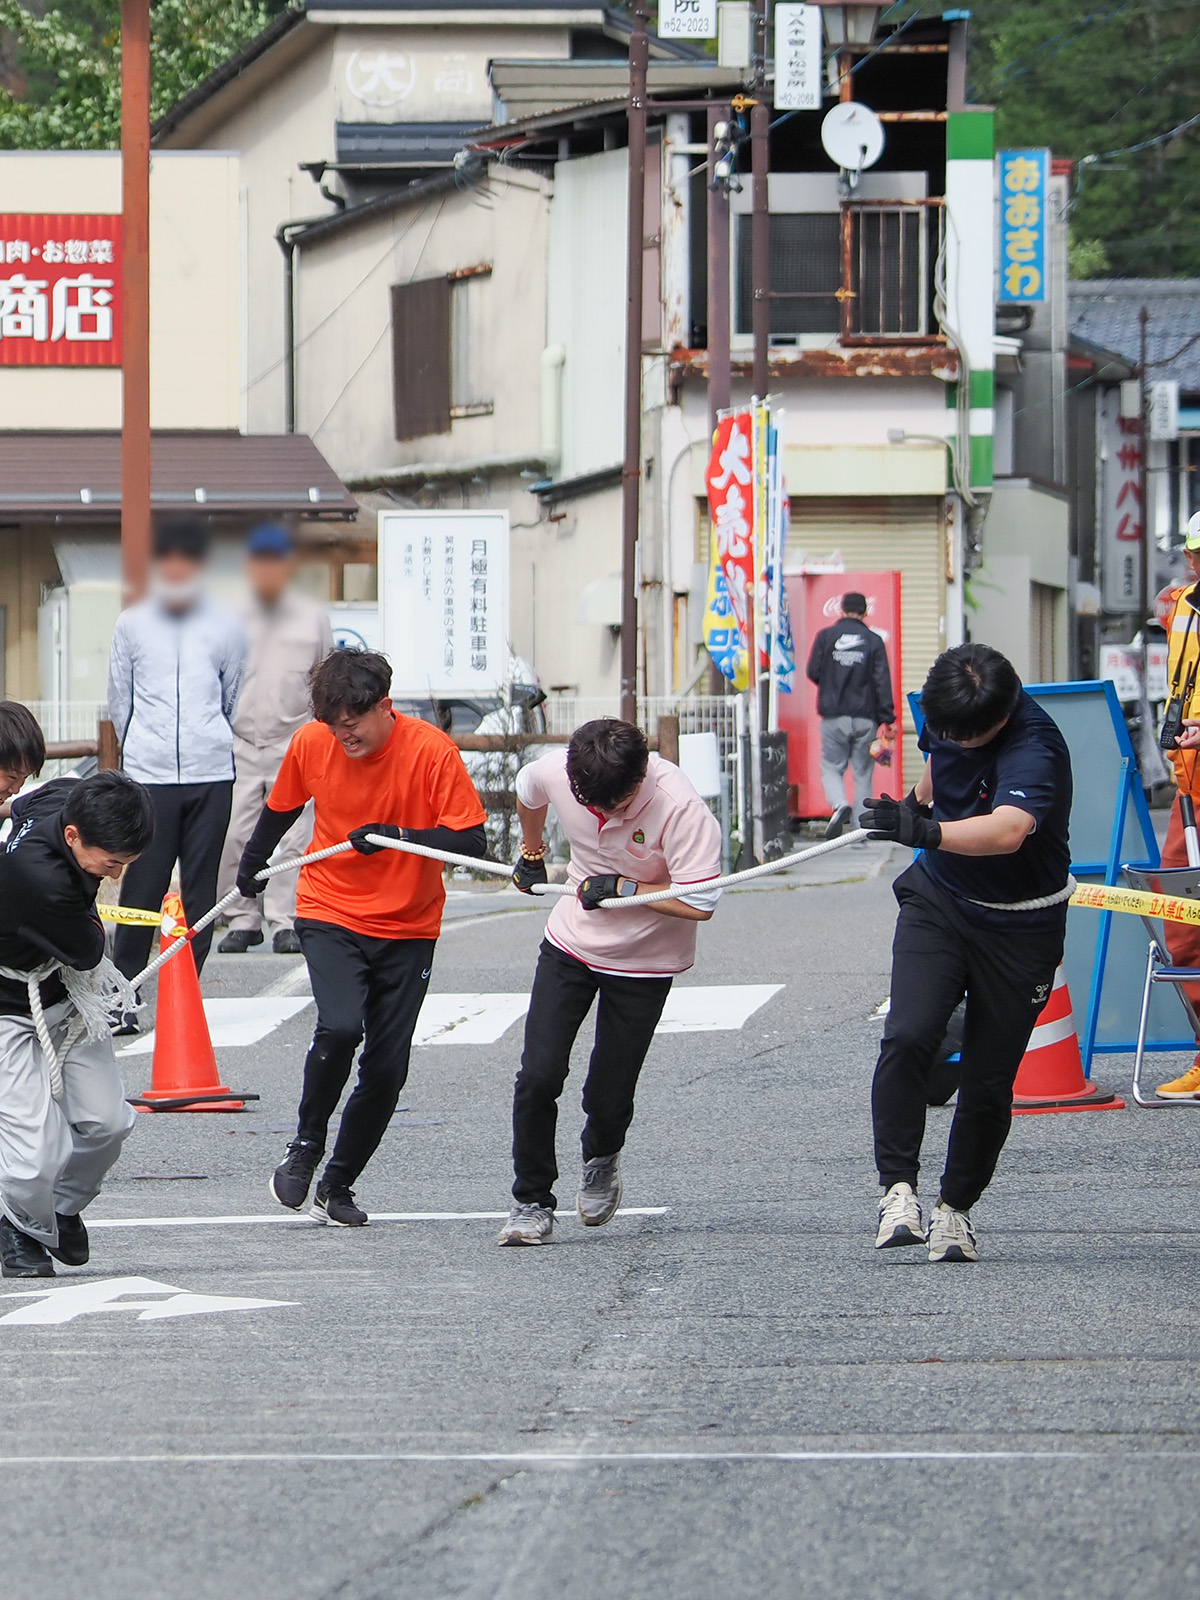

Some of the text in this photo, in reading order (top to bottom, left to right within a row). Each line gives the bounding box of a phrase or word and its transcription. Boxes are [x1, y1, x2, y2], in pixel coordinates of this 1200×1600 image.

[1005, 156, 1041, 297] おおさわ
[469, 539, 487, 671] 月極有料駐車場
[1077, 886, 1106, 907] 立入禁止
[1149, 897, 1184, 920] 立入禁止
